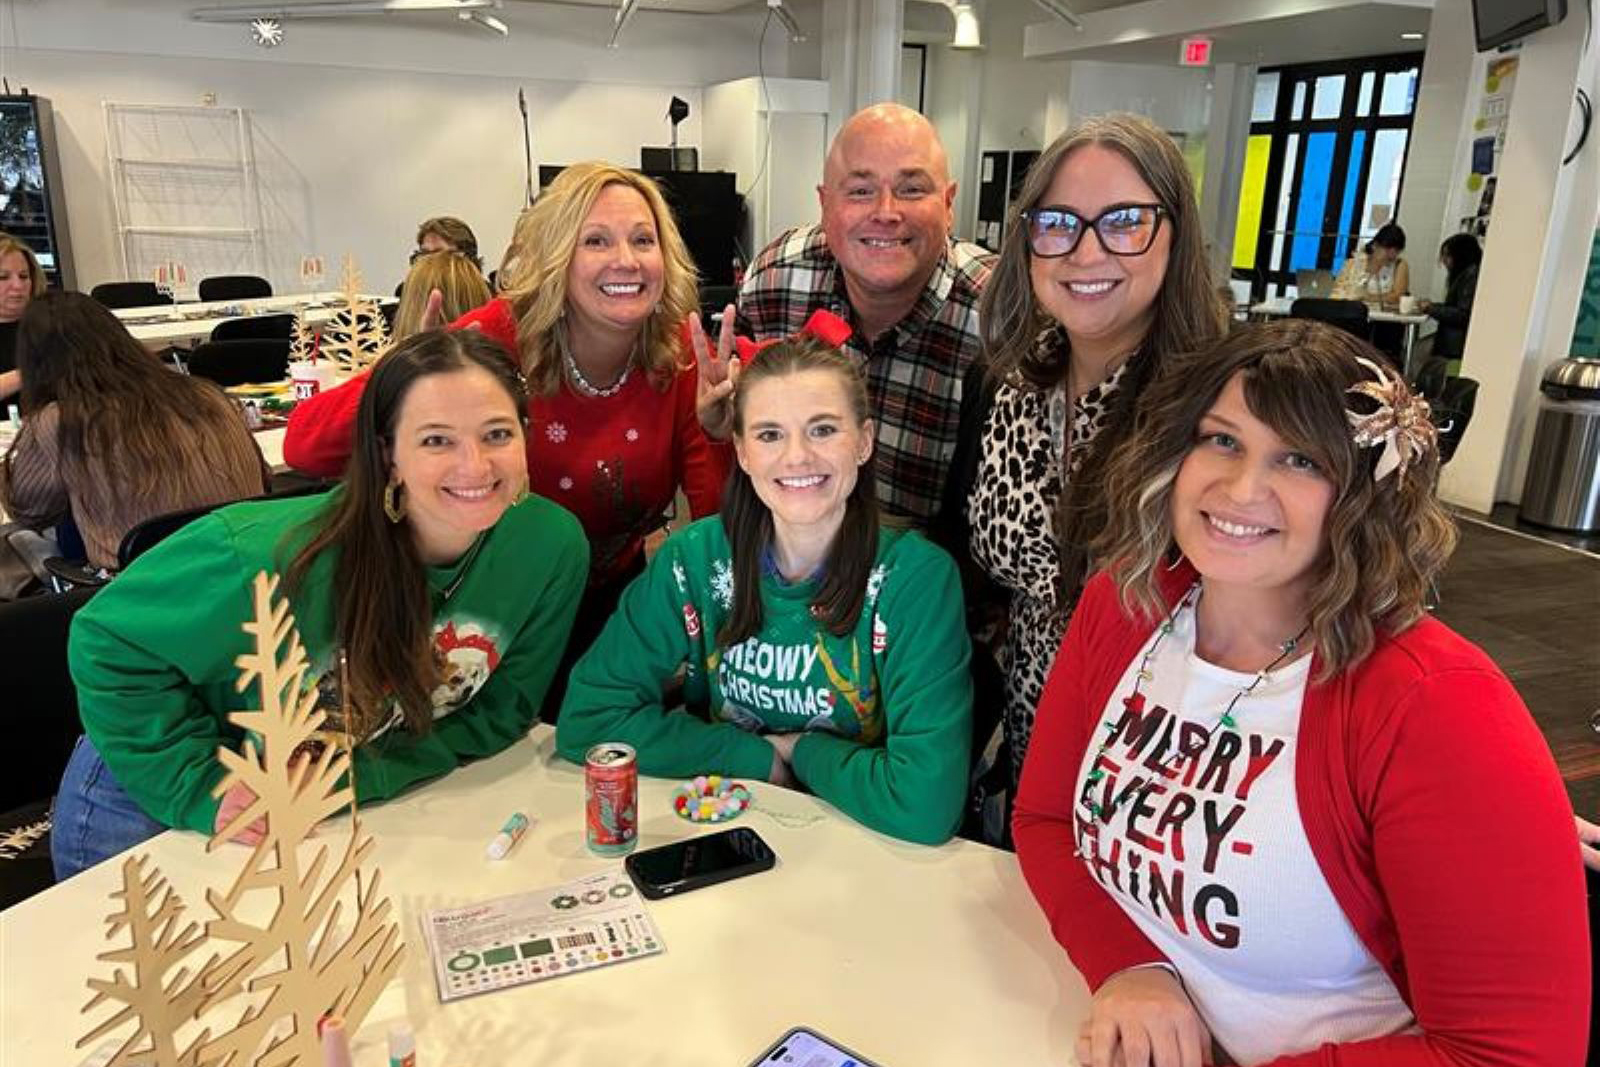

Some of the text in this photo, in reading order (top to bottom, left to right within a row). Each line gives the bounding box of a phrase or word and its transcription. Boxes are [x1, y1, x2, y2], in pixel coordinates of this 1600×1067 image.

[724, 636, 818, 682] MEOWY
[719, 663, 834, 716] CHRISTMAS
[1104, 693, 1285, 801] MERRY
